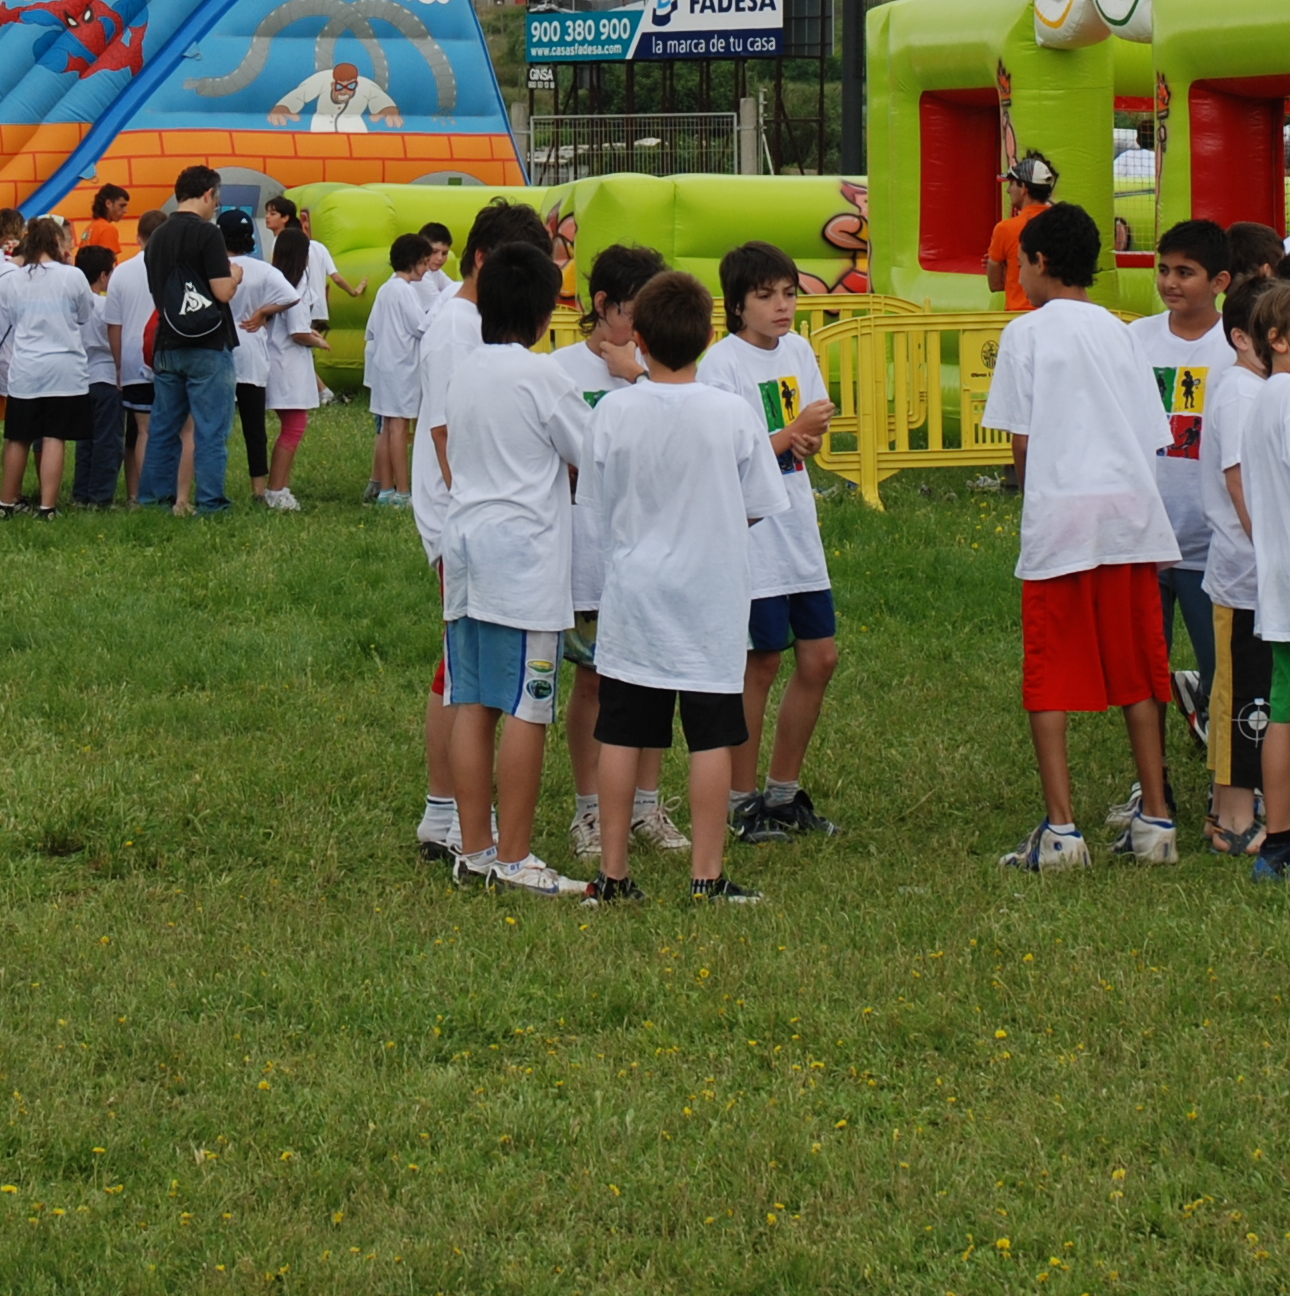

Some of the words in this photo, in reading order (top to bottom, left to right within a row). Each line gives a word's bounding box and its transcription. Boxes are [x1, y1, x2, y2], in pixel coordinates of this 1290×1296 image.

[531, 21, 560, 42] 900
[564, 20, 595, 42] 380
[600, 18, 630, 40] 900
[531, 42, 622, 56] www.casasfadesa.com
[652, 36, 663, 54] la
[667, 38, 705, 53] marca
[710, 34, 725, 52] de
[730, 36, 743, 52] tu
[747, 37, 776, 51] casa
